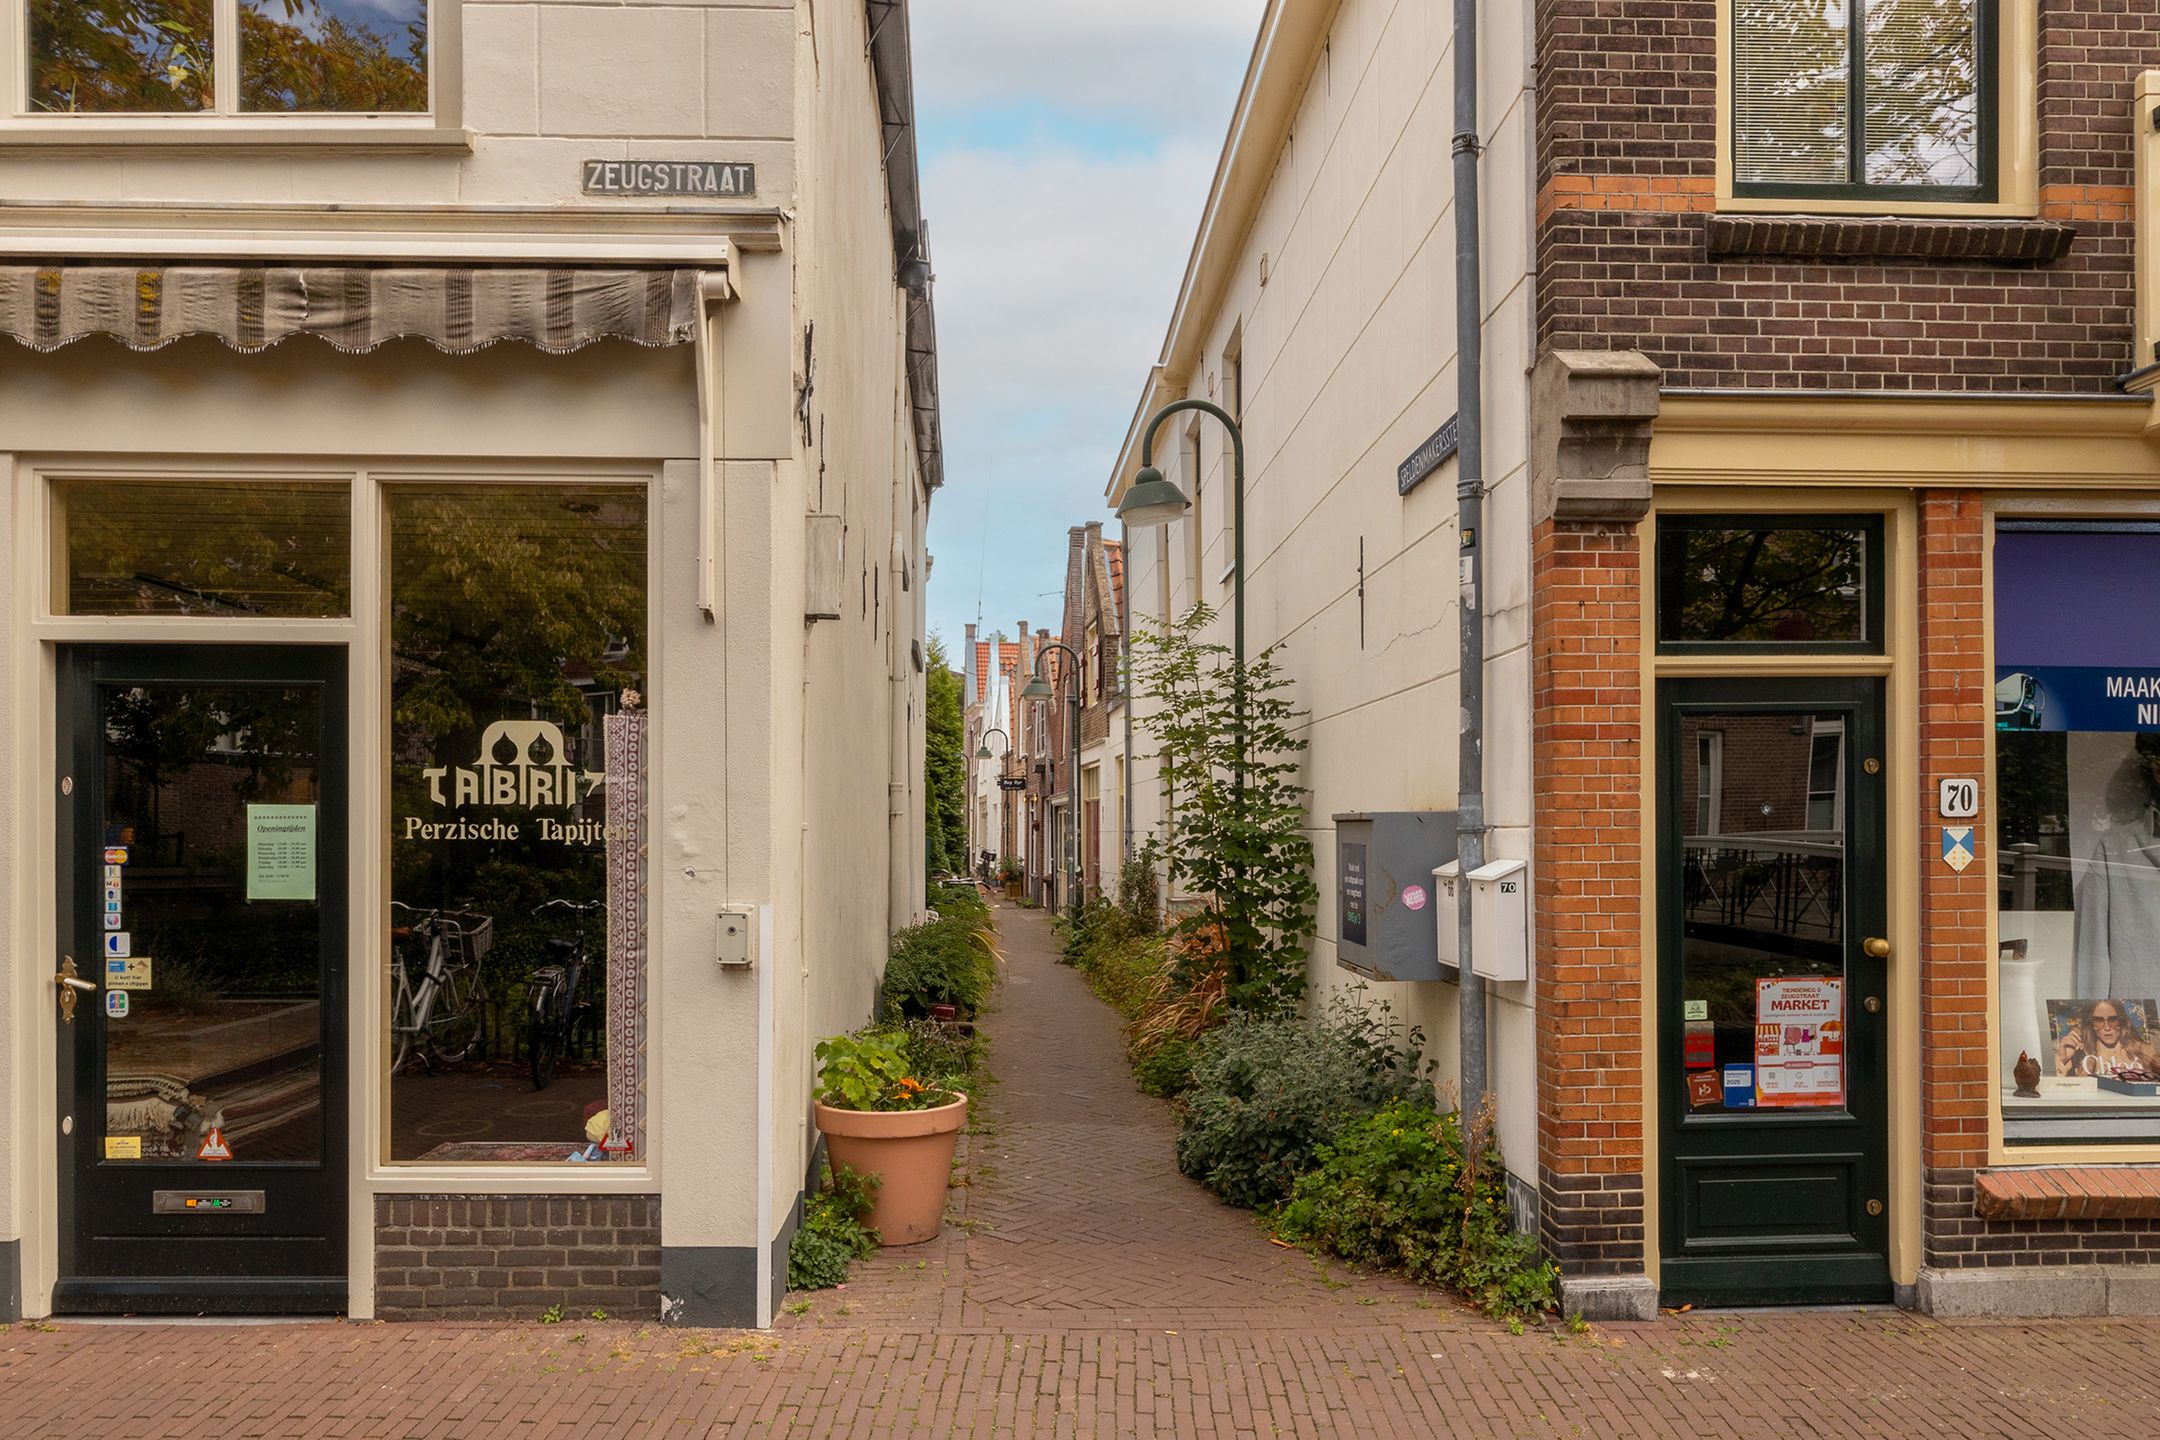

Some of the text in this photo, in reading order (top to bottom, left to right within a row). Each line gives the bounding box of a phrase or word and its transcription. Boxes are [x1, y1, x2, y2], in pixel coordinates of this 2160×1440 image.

[588, 163, 750, 192] ZEUGSTRAAT
[2106, 676, 2160, 698] MAAK
[2137, 703, 2160, 725] NI
[1947, 784, 1973, 812] 70
[256, 824, 307, 833] Openingtijden
[404, 816, 520, 840] Perzische
[1501, 882, 1516, 893] 70
[1771, 1000, 1829, 1011] MARKET
